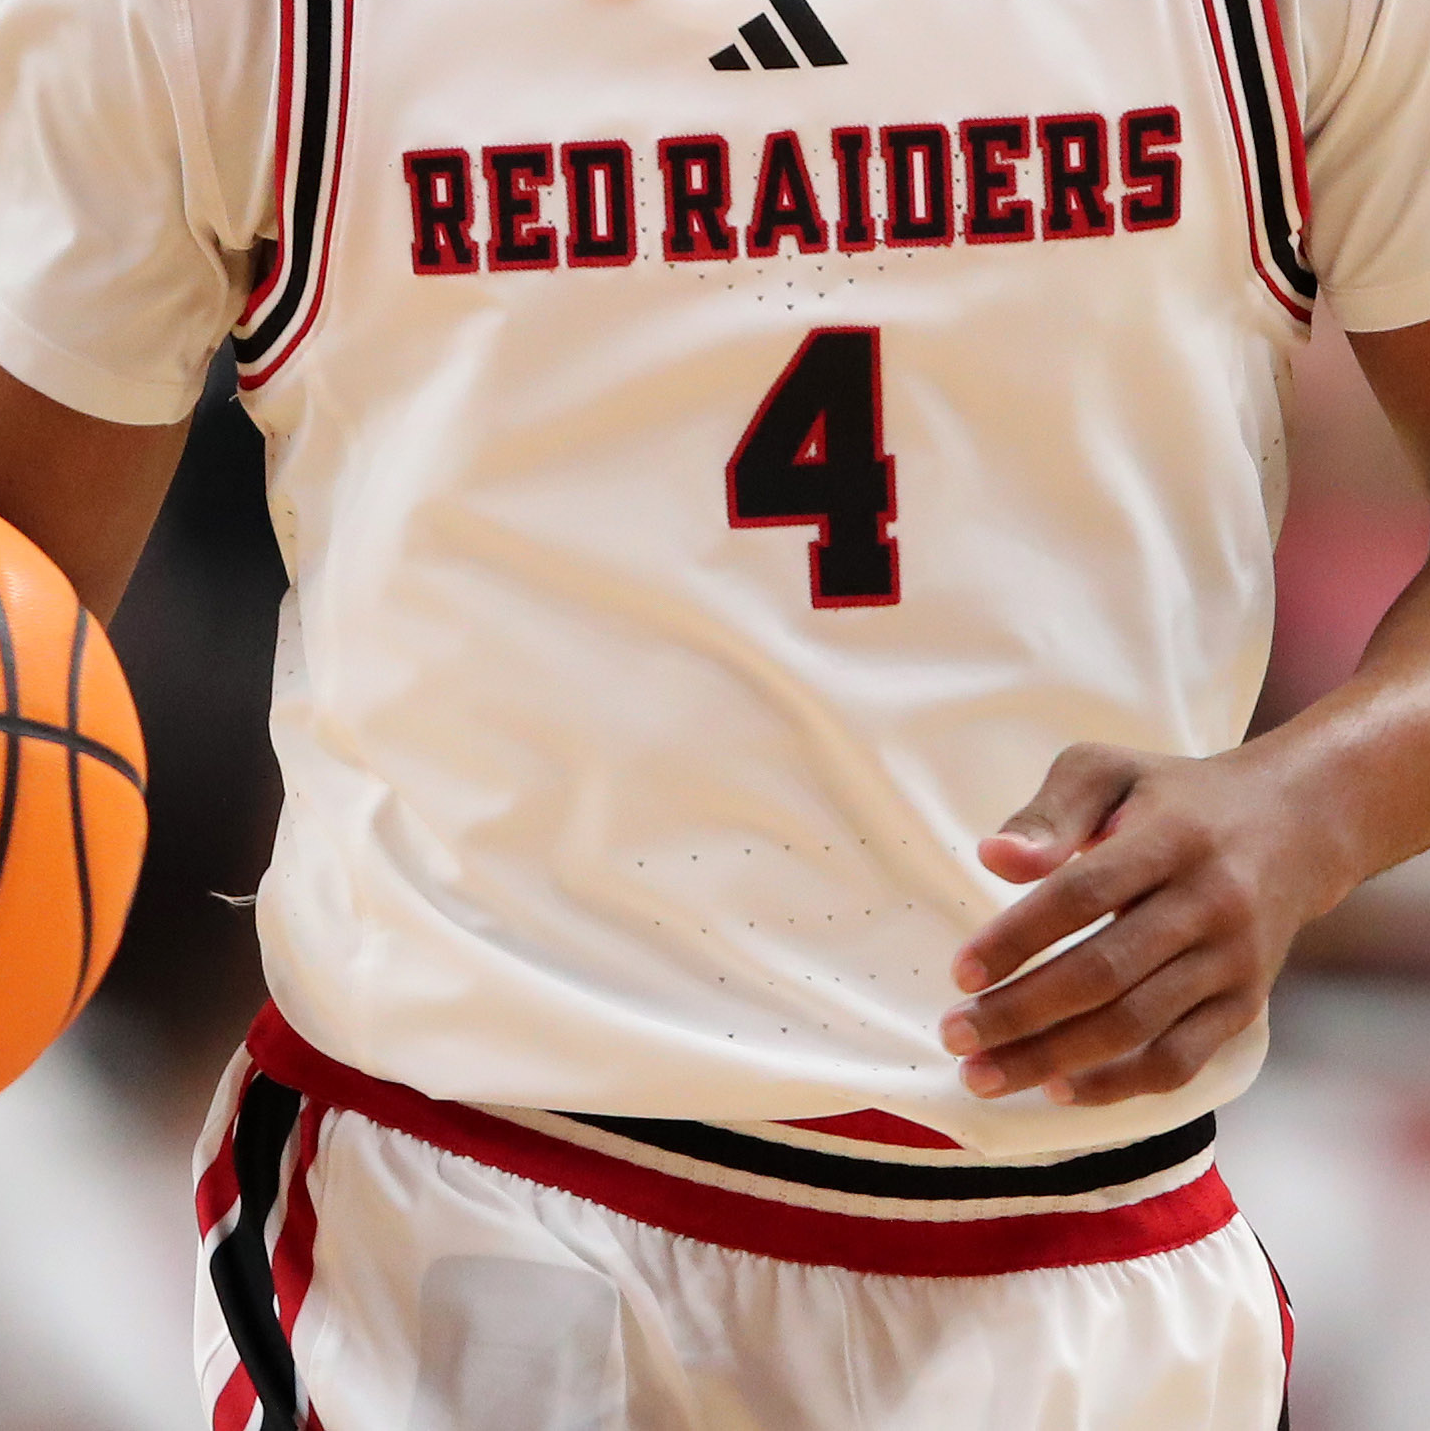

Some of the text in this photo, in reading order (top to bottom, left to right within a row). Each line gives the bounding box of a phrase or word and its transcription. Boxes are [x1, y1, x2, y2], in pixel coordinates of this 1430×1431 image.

[404, 106, 1182, 275] RED RAIDERS
[726, 326, 901, 609] 4
